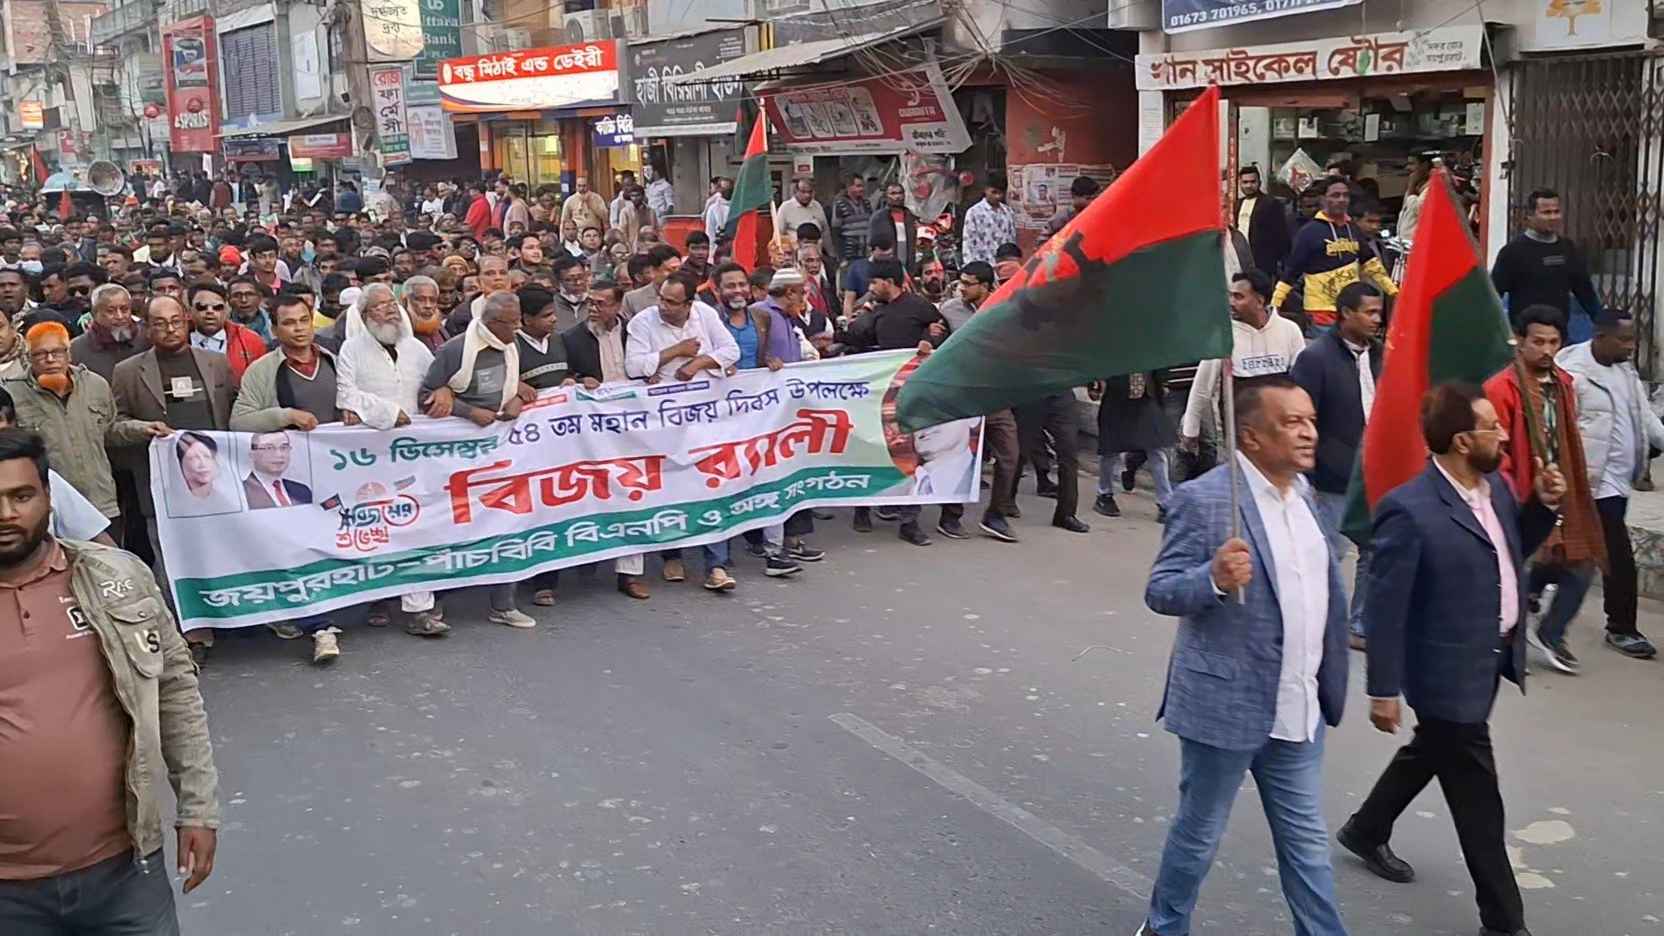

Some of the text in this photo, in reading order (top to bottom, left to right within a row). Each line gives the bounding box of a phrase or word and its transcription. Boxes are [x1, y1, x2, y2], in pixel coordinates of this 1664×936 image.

[1170, 11, 1207, 26] 01673
[1210, 3, 1261, 20] 701965,
[424, 33, 457, 44] Bank
[478, 57, 518, 77] মিঠাই
[521, 59, 549, 72] এন্ড
[554, 45, 604, 70] ডেইরী
[1150, 56, 1198, 84] খান
[1201, 49, 1319, 83] সাইকেল
[634, 67, 660, 108] হাজী
[508, 377, 869, 445] ৫৪ তম মহান বিজয় দিবস উপলক্ষে
[330, 436, 498, 470] ১৬ ডিসেম্বর
[443, 455, 666, 524] বিজয়
[566, 510, 688, 544] বিএনপি
[697, 511, 722, 528] ও
[729, 490, 782, 513] অঙ্গ
[784, 471, 870, 500] সংগঠন
